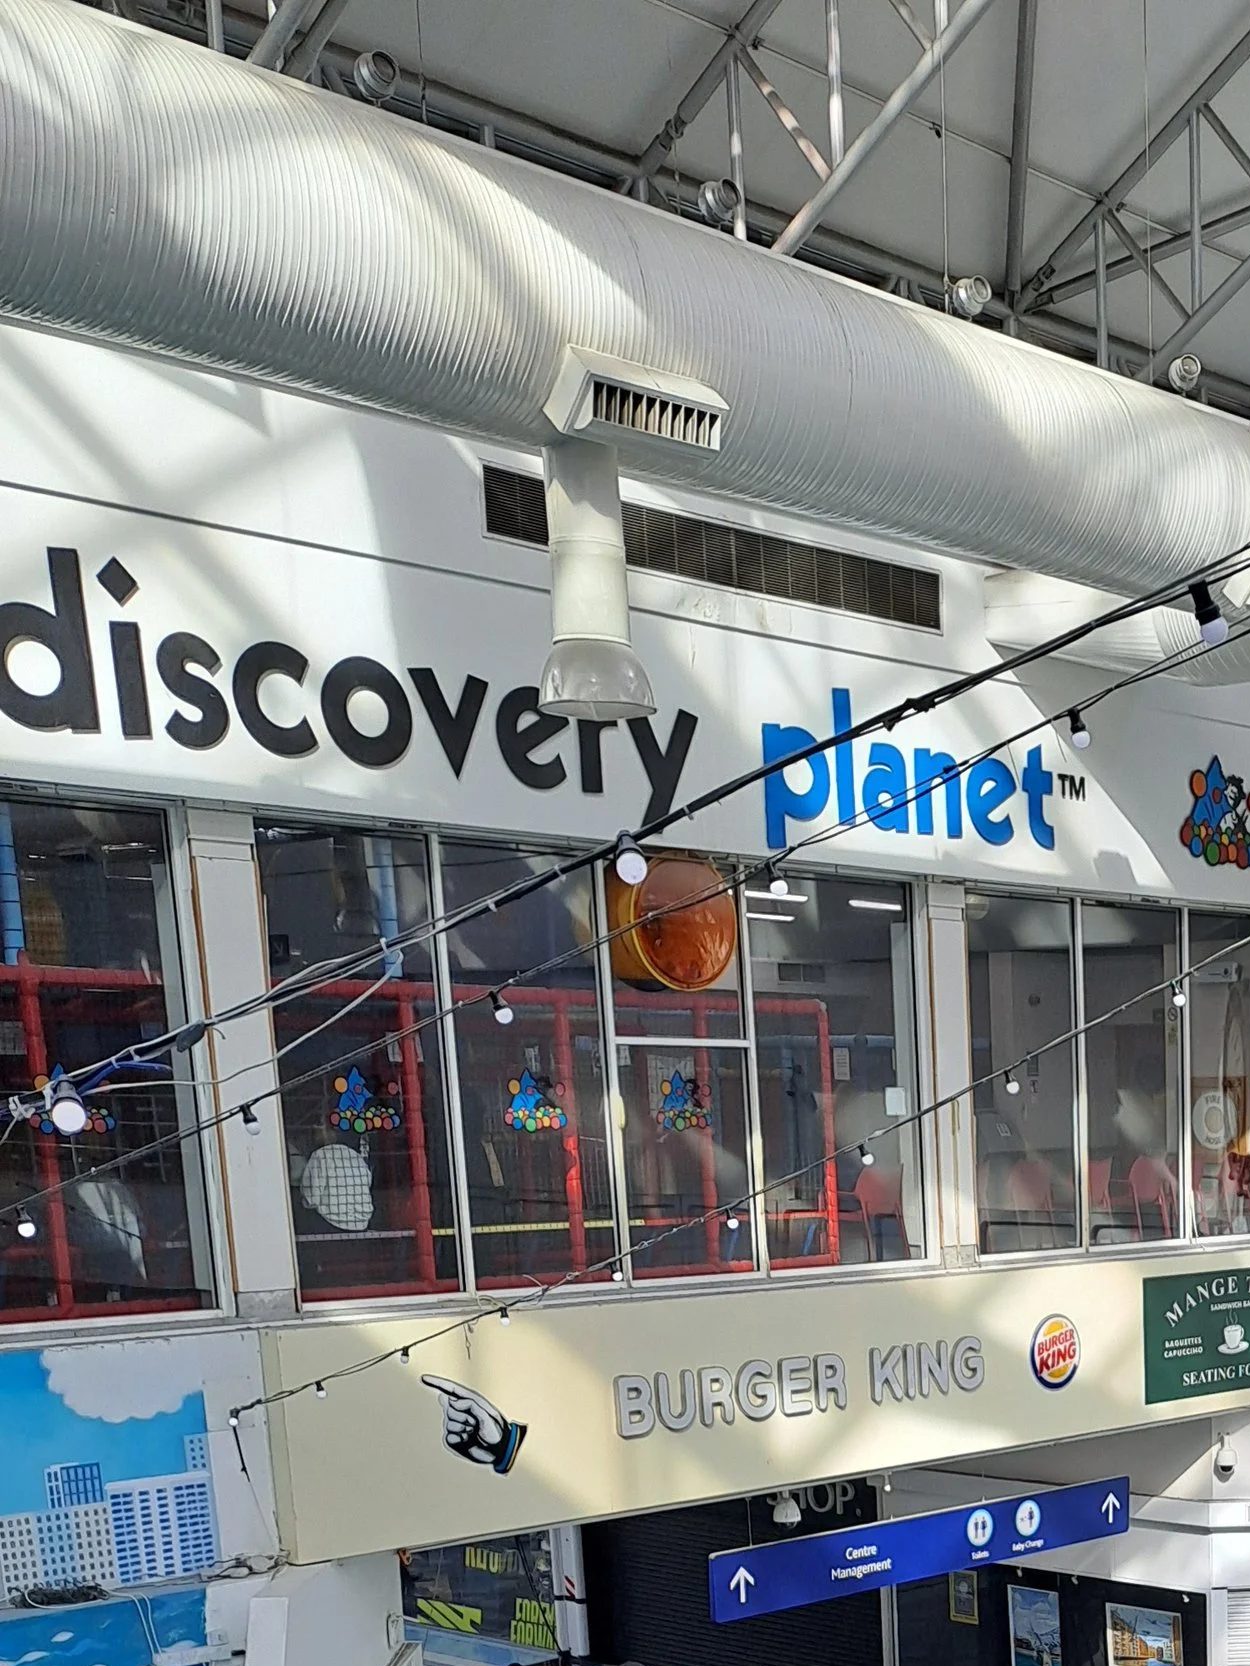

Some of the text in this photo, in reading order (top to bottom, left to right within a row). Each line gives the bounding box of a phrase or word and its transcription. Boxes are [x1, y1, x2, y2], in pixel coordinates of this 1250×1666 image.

[0, 546, 698, 834] discovery
[761, 687, 1056, 850] planet
[1164, 1276, 1238, 1328] MANGE
[1210, 1301, 1243, 1311] SANDWICH
[1037, 1328, 1075, 1357] BURGER
[1164, 1337, 1202, 1348] BAGUETTES
[1164, 1346, 1203, 1358] CAPUCCINO
[1038, 1341, 1077, 1376] KING
[1182, 1366, 1235, 1386] SEATING
[613, 1335, 985, 1440] BURGER KING
[845, 1545, 877, 1560] Centre
[971, 1550, 990, 1560] Toilets
[1012, 1539, 1044, 1552] Baby Change
[831, 1557, 892, 1580] Management
